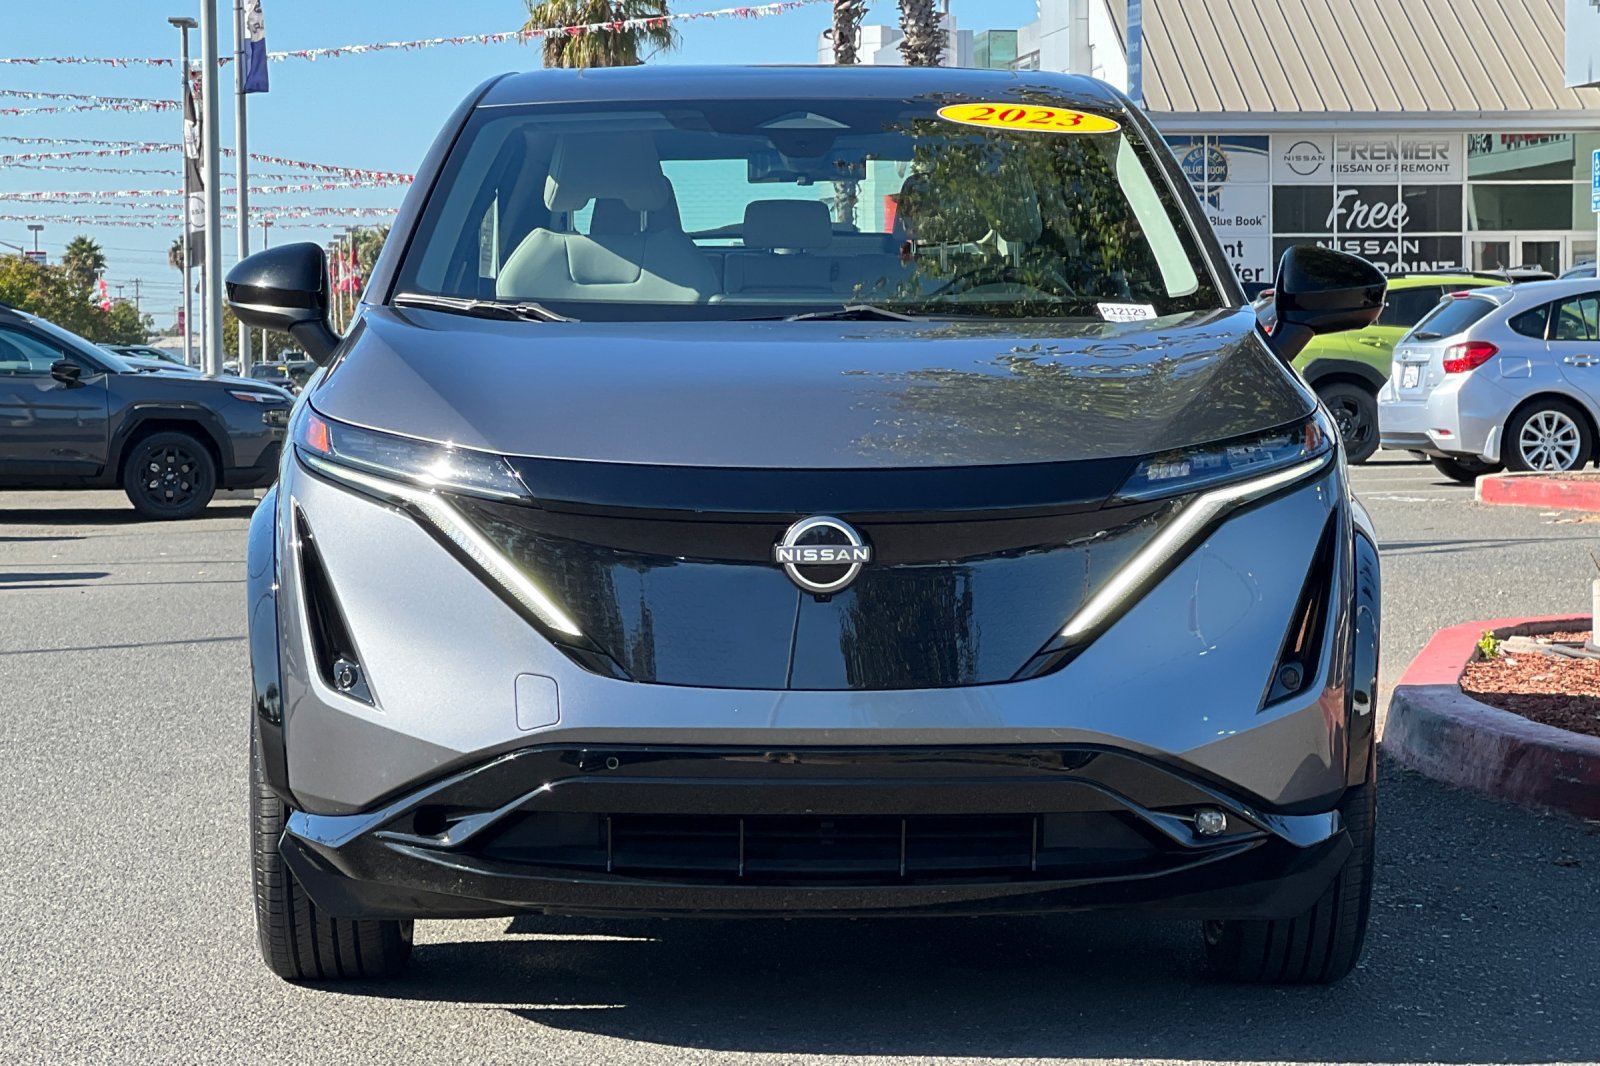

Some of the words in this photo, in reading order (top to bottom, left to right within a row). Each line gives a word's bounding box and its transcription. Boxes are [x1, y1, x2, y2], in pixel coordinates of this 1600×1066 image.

[967, 107, 1084, 127] 2023
[1336, 140, 1450, 160] PREMIER
[1375, 163, 1391, 173] OF
[1394, 163, 1450, 173] FREMONT
[1325, 189, 1410, 230] Free
[1101, 306, 1147, 317] P12129
[779, 548, 868, 561] NISSAN
